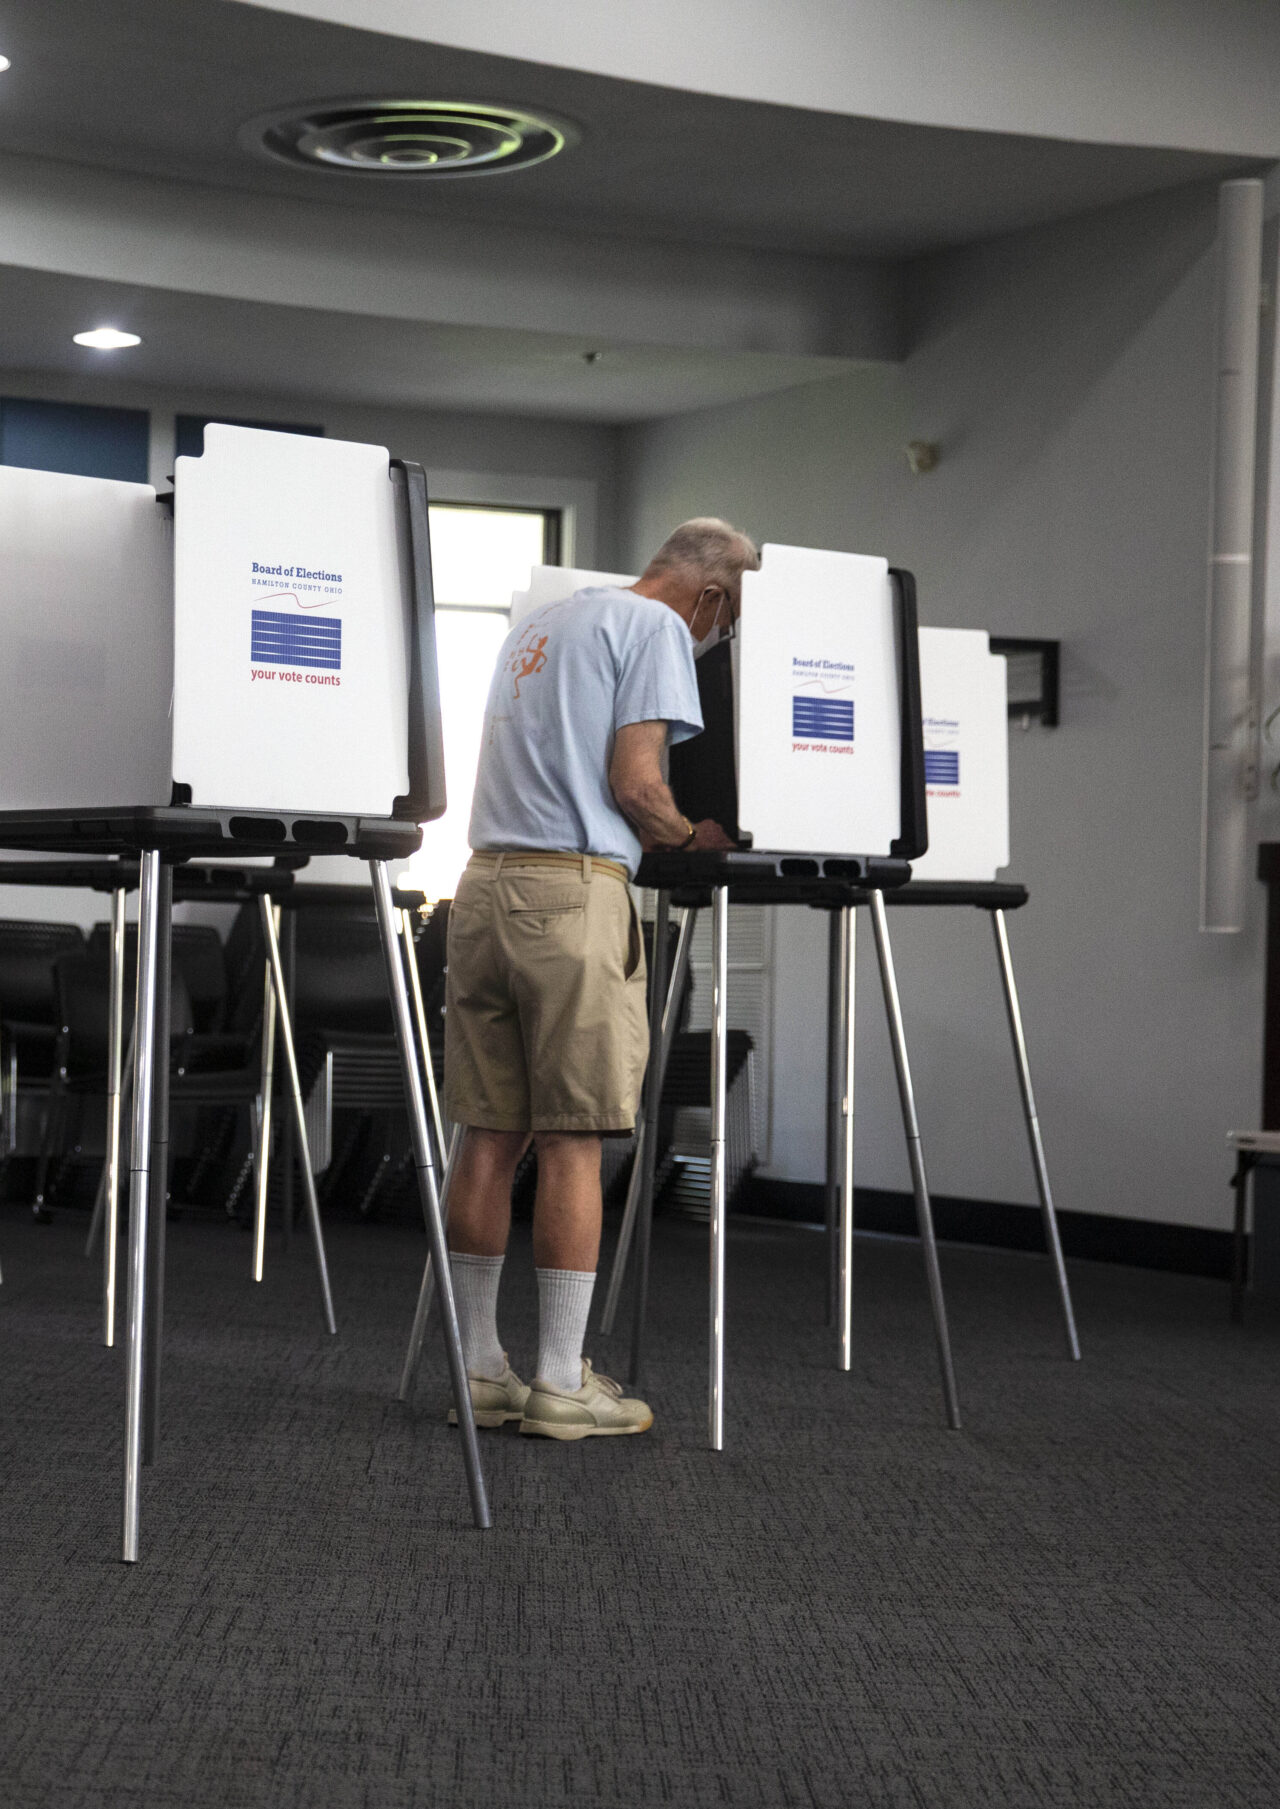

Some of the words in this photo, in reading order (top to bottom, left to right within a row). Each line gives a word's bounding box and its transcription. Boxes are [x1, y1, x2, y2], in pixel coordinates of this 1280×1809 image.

[251, 562, 282, 576] Board
[284, 566, 294, 577] of
[296, 567, 343, 582] Elections
[251, 578, 289, 588] HAMILTON
[292, 583, 321, 592] COUNTY
[325, 586, 343, 594] OHIO
[792, 657, 813, 667] Board
[814, 660, 822, 668] of
[823, 660, 854, 671] Elections
[251, 669, 276, 681] your
[279, 671, 303, 683] vote
[305, 674, 341, 686] counts
[792, 742, 809, 752] your
[811, 743, 827, 753] vote
[829, 745, 854, 755] counts
